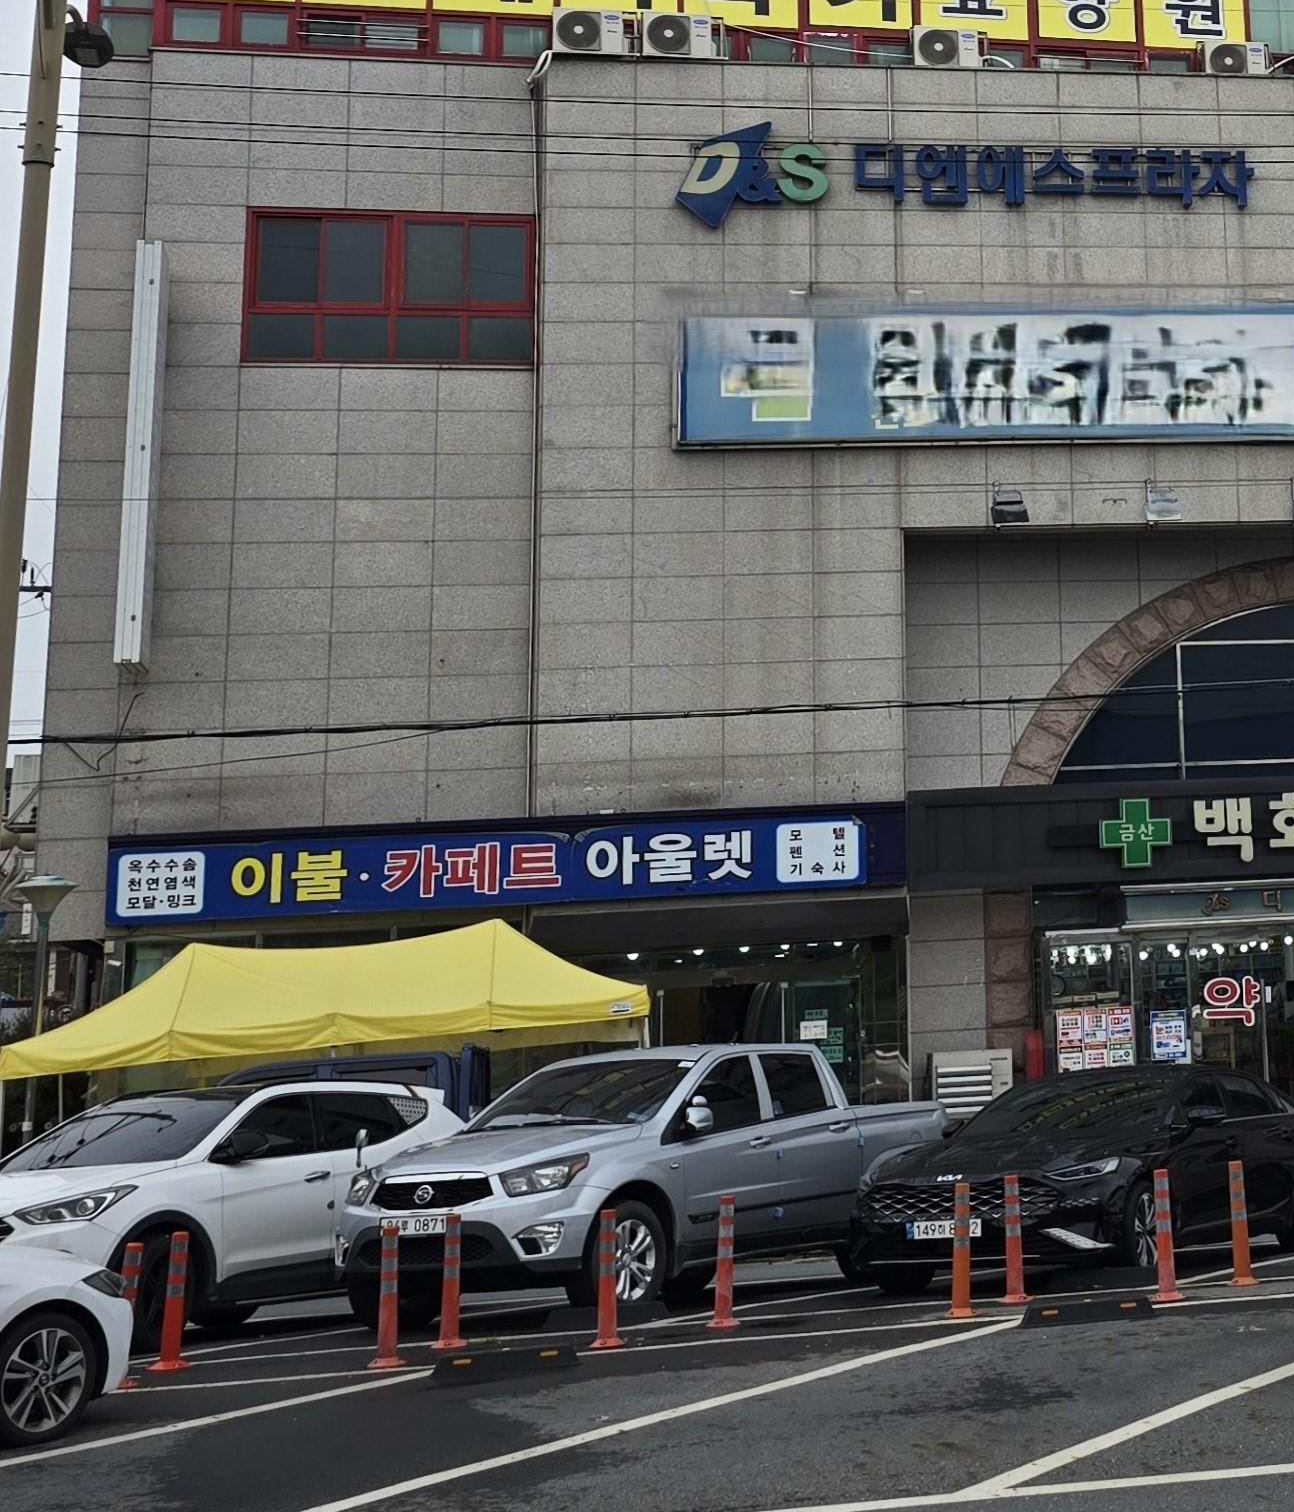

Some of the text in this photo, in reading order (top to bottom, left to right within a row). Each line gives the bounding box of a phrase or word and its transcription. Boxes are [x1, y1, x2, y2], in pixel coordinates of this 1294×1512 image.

[680, 142, 829, 204] D&S
[854, 142, 1255, 210] 디엔에스프라자
[787, 826, 848, 843] 모텔
[1118, 821, 1155, 842] 금산
[585, 828, 755, 883] 아울렛
[788, 843, 848, 860] 펜션
[127, 857, 198, 874] 옥수수솜
[788, 860, 848, 877] 기숙사
[127, 875, 197, 892] 천연염색
[1204, 975, 1261, 1027] 약
[414, 1217, 445, 1232] 0871
